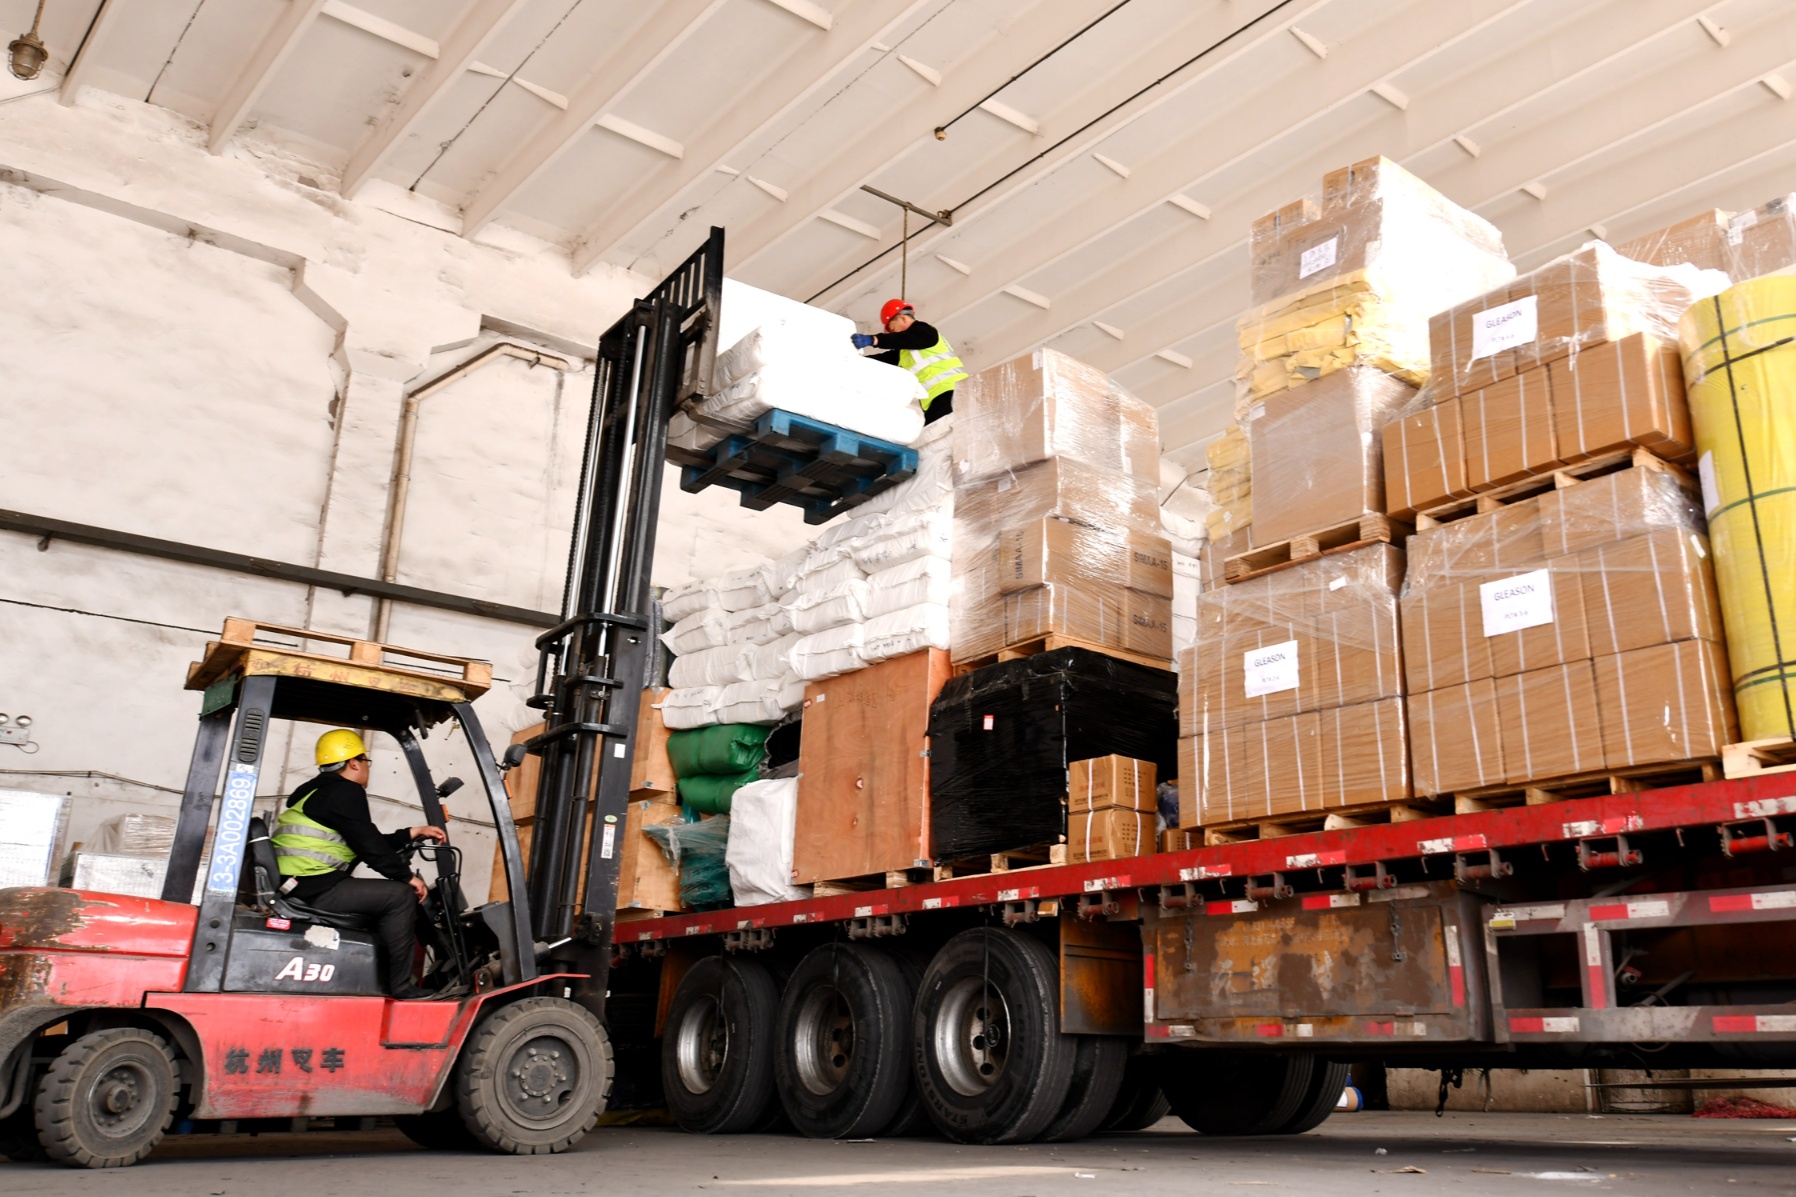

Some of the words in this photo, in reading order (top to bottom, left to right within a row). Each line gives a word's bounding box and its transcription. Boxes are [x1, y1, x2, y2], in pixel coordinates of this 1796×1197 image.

[1486, 311, 1521, 328] GLEASON
[1015, 531, 1024, 579] SIMAA-15
[1134, 552, 1168, 570] SIMAA-15
[1493, 584, 1535, 601] GLEASON
[1254, 653, 1286, 667] GLEASON
[213, 778, 252, 883] 3-3A002869
[275, 957, 336, 982] A30
[224, 1047, 346, 1074] 杭州叉车
